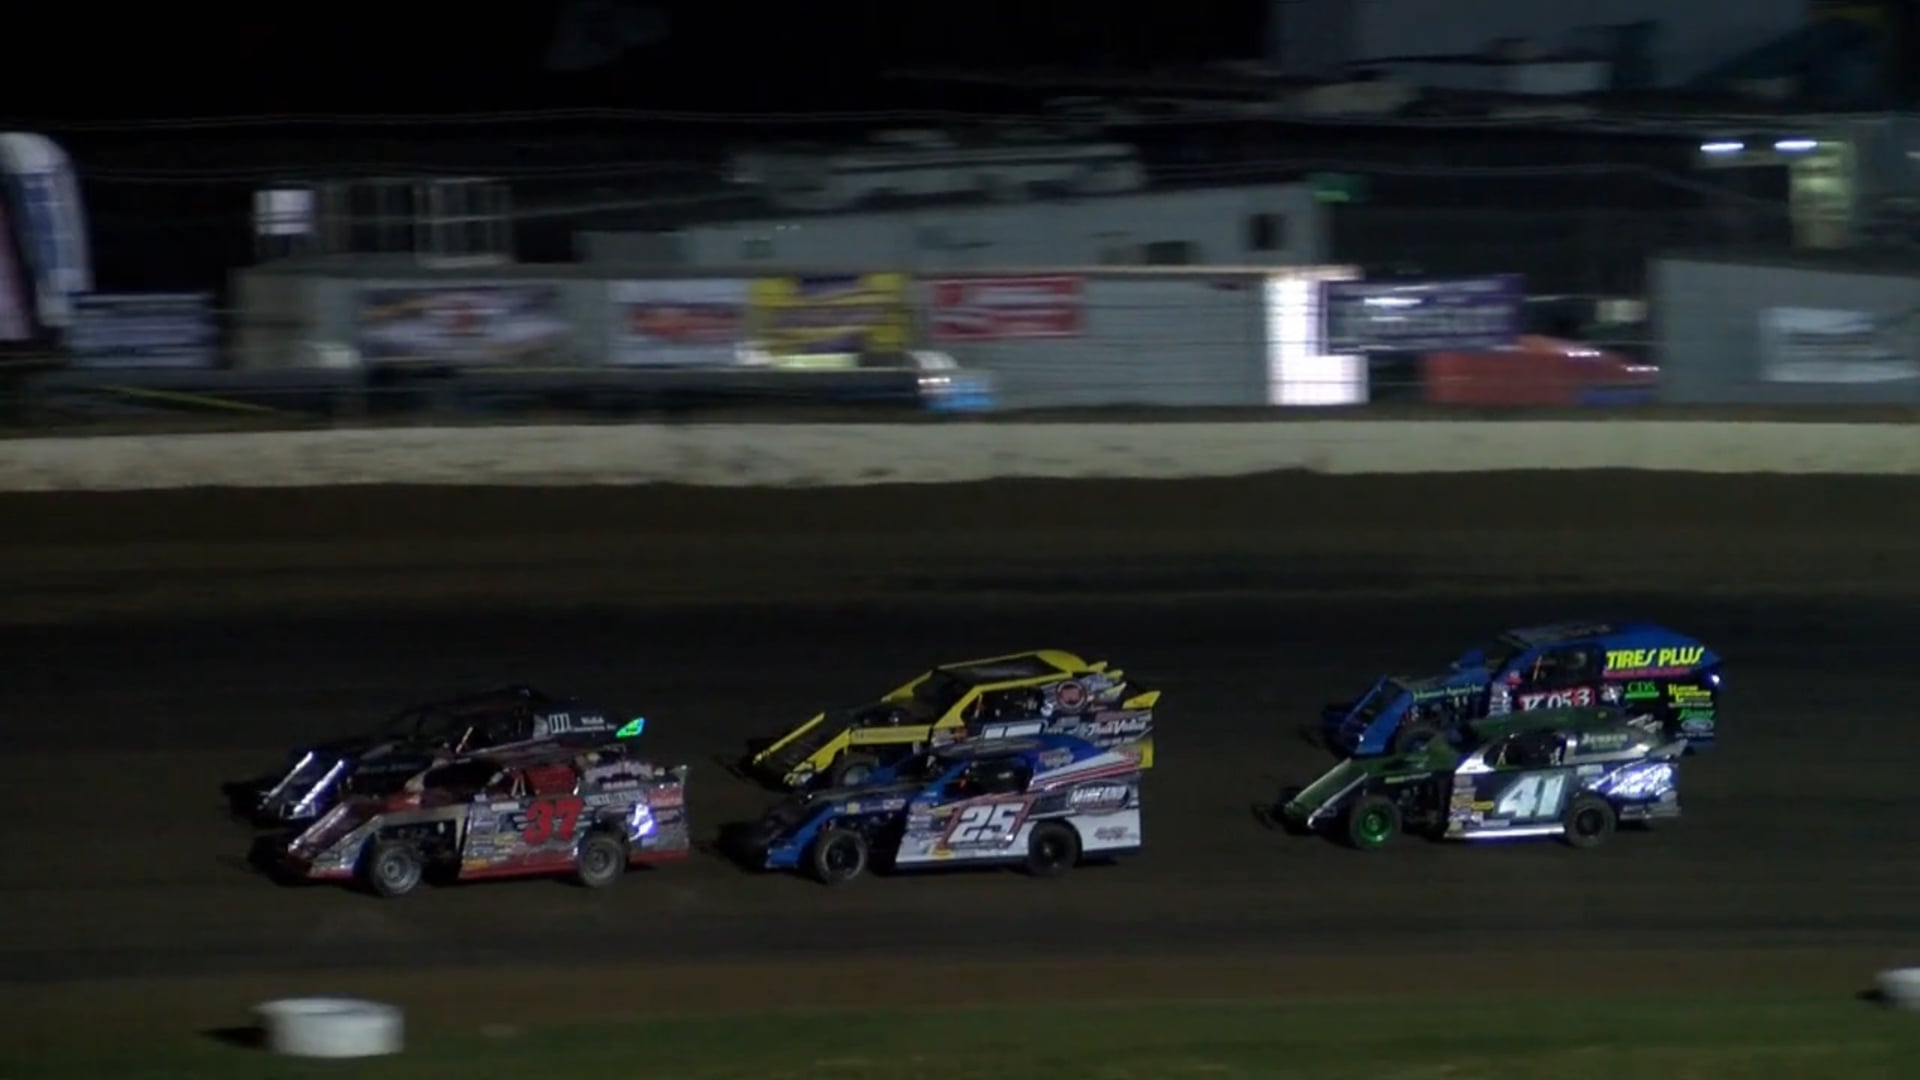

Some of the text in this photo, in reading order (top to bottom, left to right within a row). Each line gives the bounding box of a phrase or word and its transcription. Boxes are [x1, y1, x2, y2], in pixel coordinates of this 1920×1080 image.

[1606, 646, 1704, 669] TIRES PLUS
[1497, 773, 1565, 818] 41
[523, 796, 585, 846] 37
[948, 803, 1025, 843] 25
